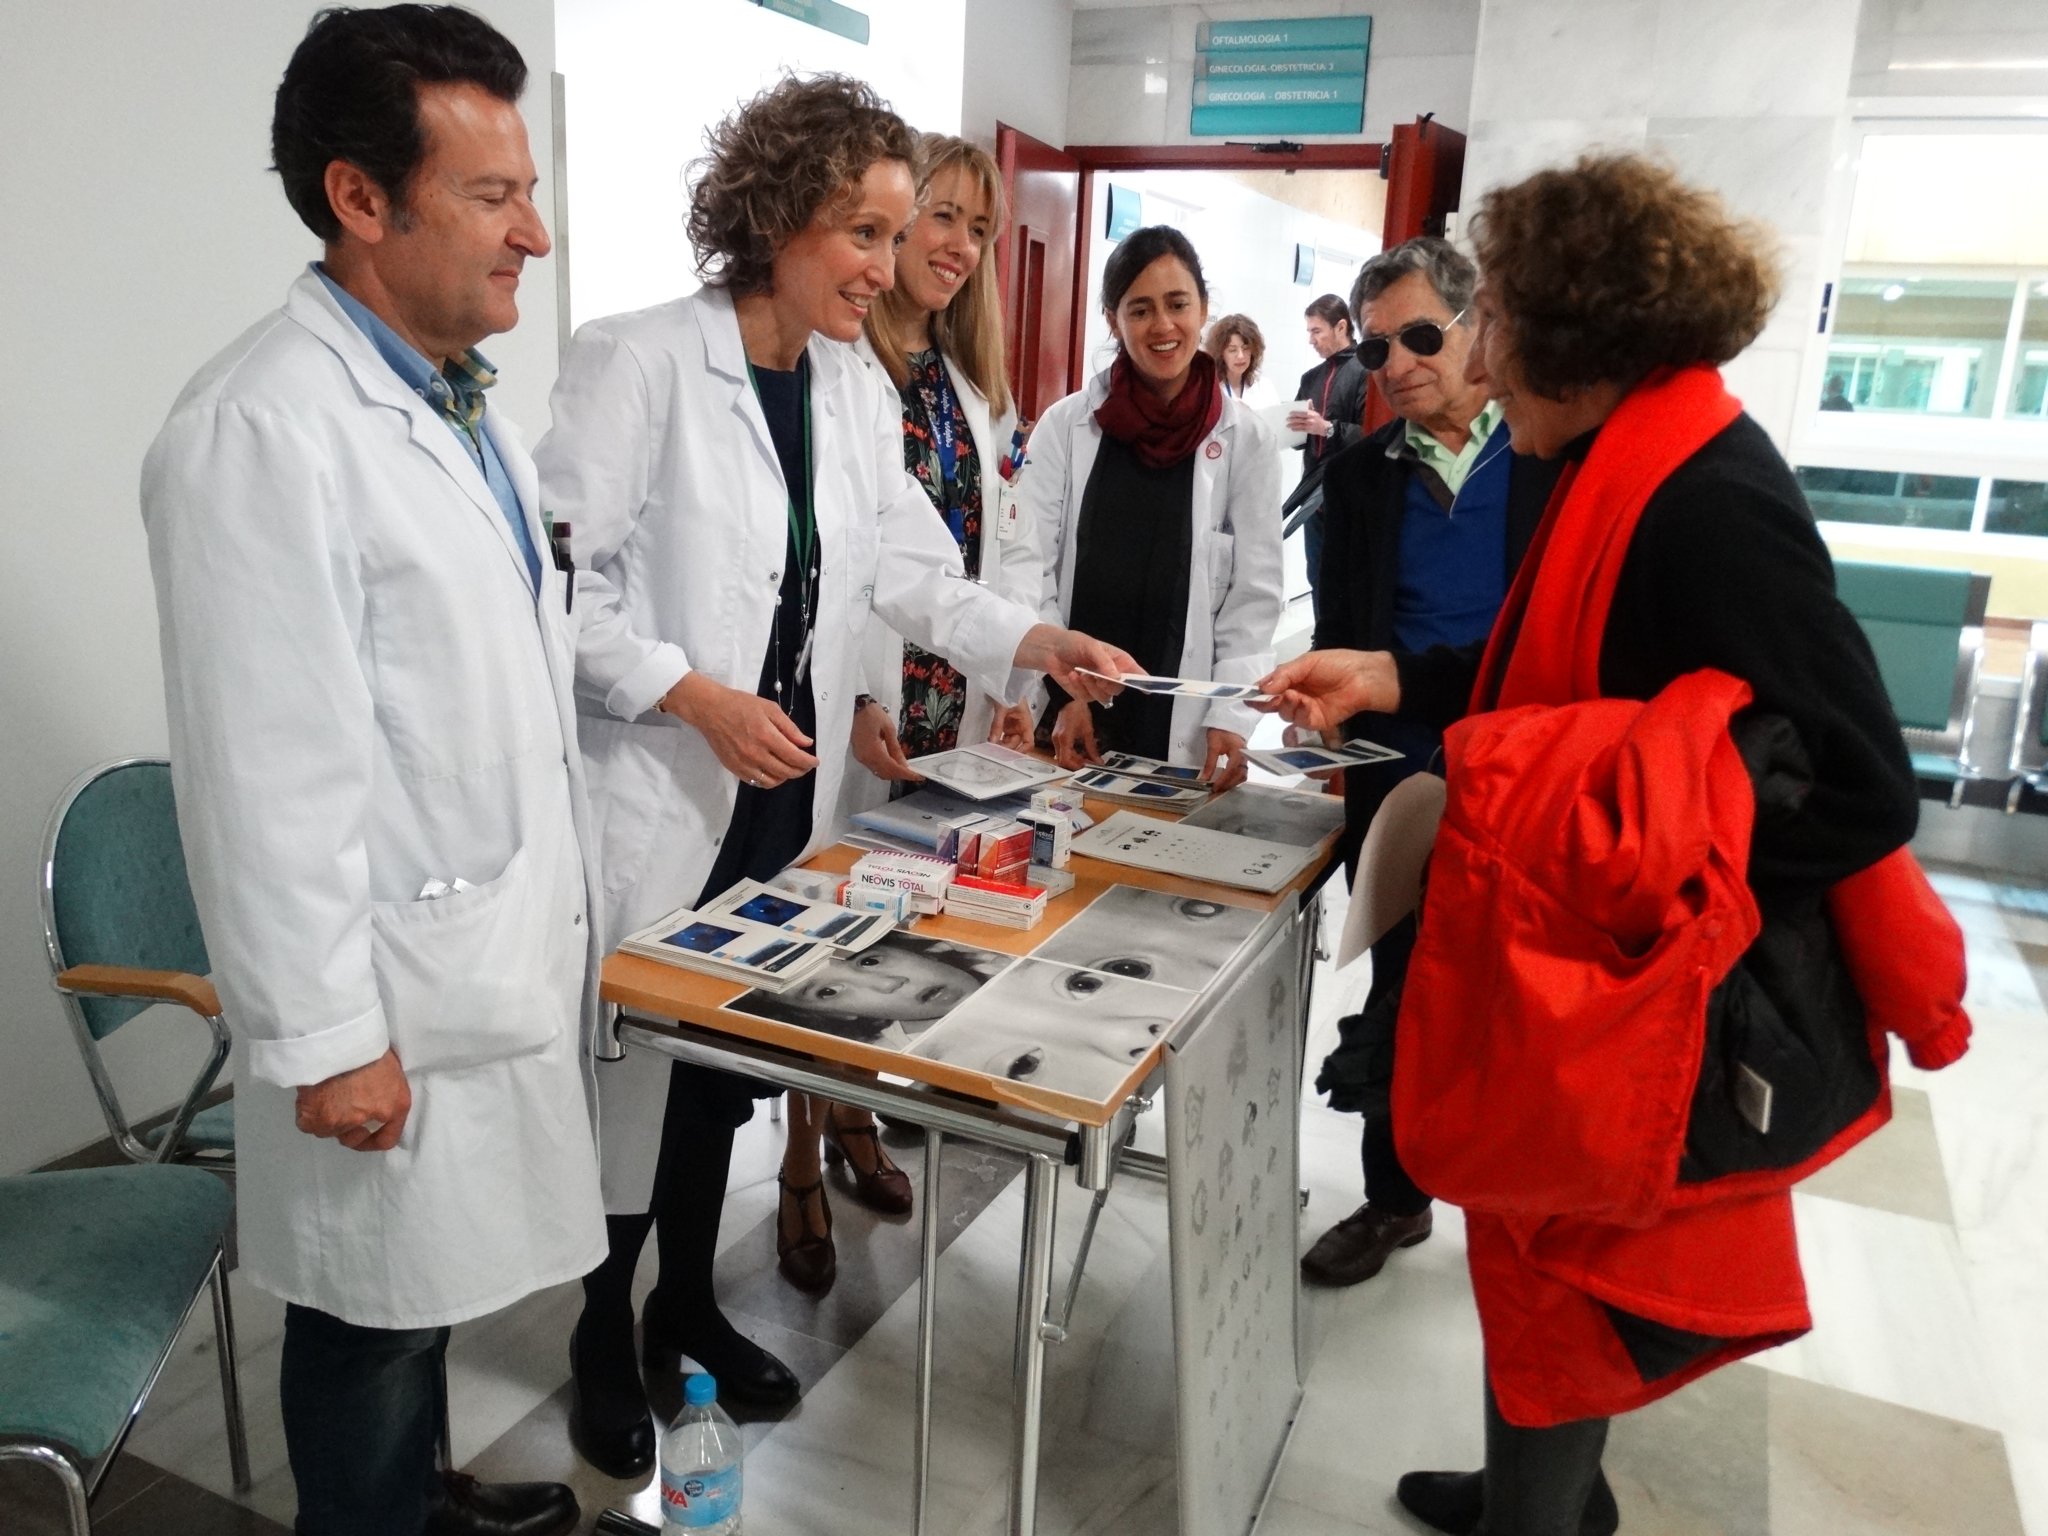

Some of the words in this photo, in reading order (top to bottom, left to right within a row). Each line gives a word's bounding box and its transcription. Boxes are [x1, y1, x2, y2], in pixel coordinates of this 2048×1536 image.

[1212, 34, 1280, 45] OFTALMOLOGIA
[1209, 92, 1265, 101] GINECOLOGIA
[1274, 91, 1330, 101] OBSTETRICIA
[861, 873, 896, 888] NEOVIS
[898, 878, 926, 893] TOTAL
